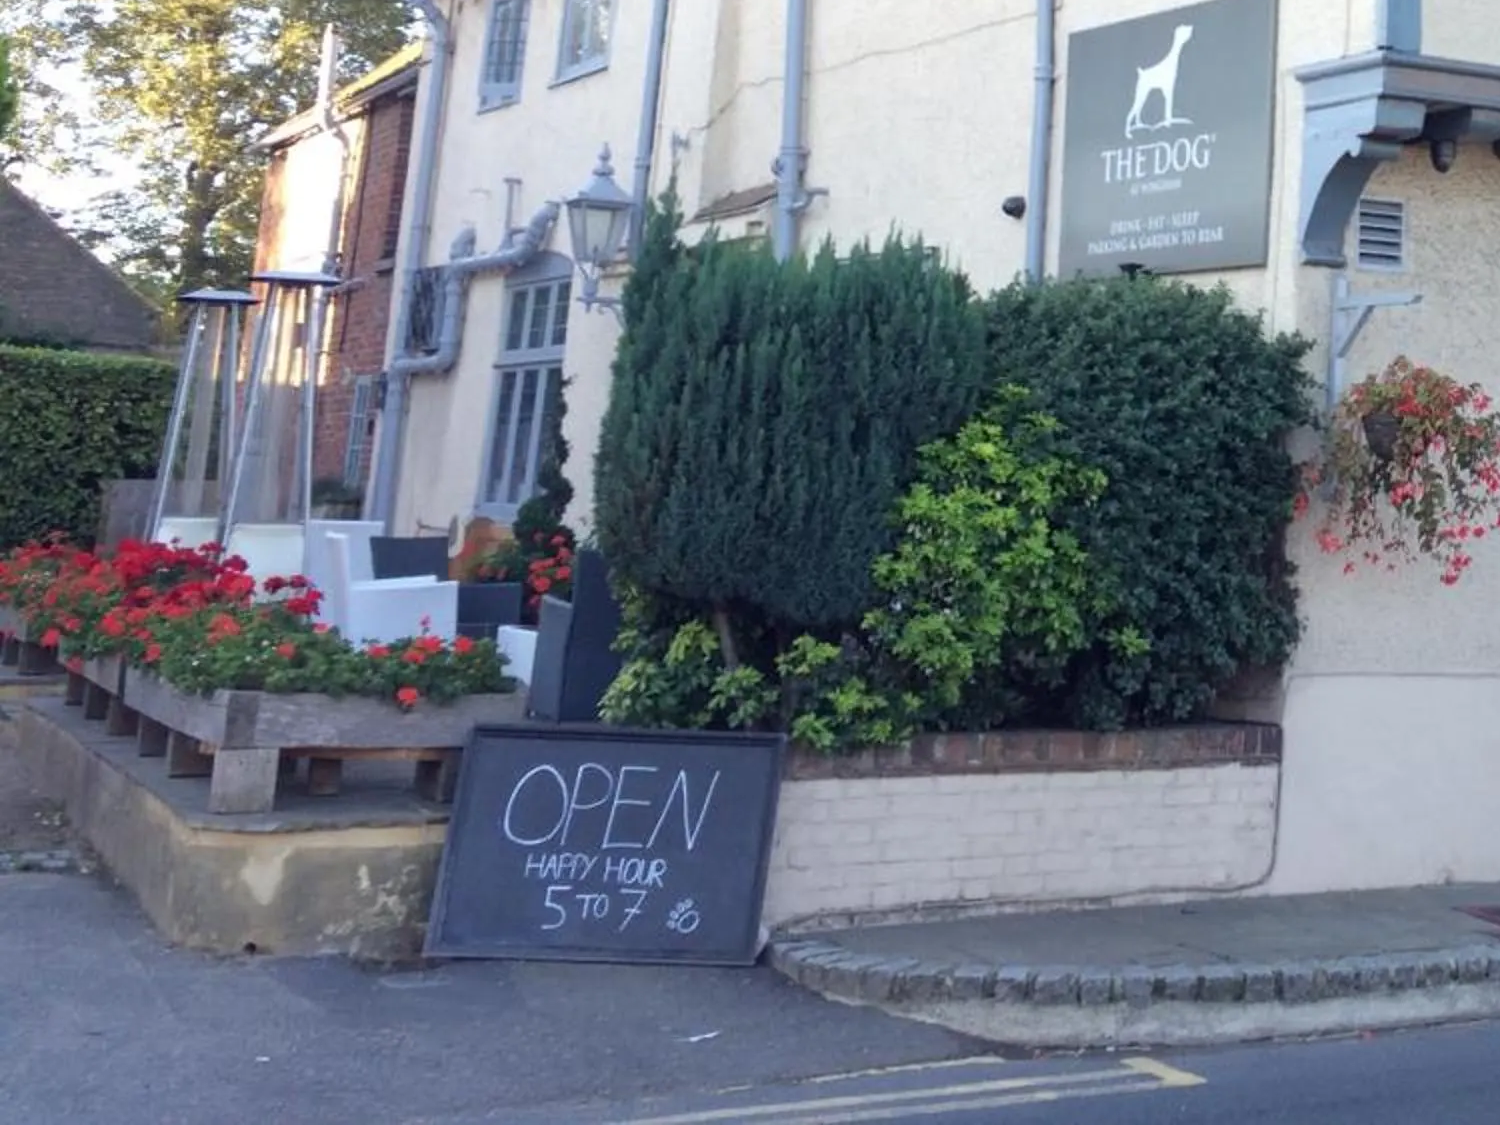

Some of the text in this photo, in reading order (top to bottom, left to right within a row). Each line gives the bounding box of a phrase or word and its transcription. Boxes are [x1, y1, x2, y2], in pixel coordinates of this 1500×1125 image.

[1100, 134, 1210, 183] THE DOG
[1182, 228, 1197, 246] TO
[504, 762, 721, 851] OPEN
[525, 852, 667, 888] HAPPY HOUR
[541, 885, 648, 932] 5 TO 7
